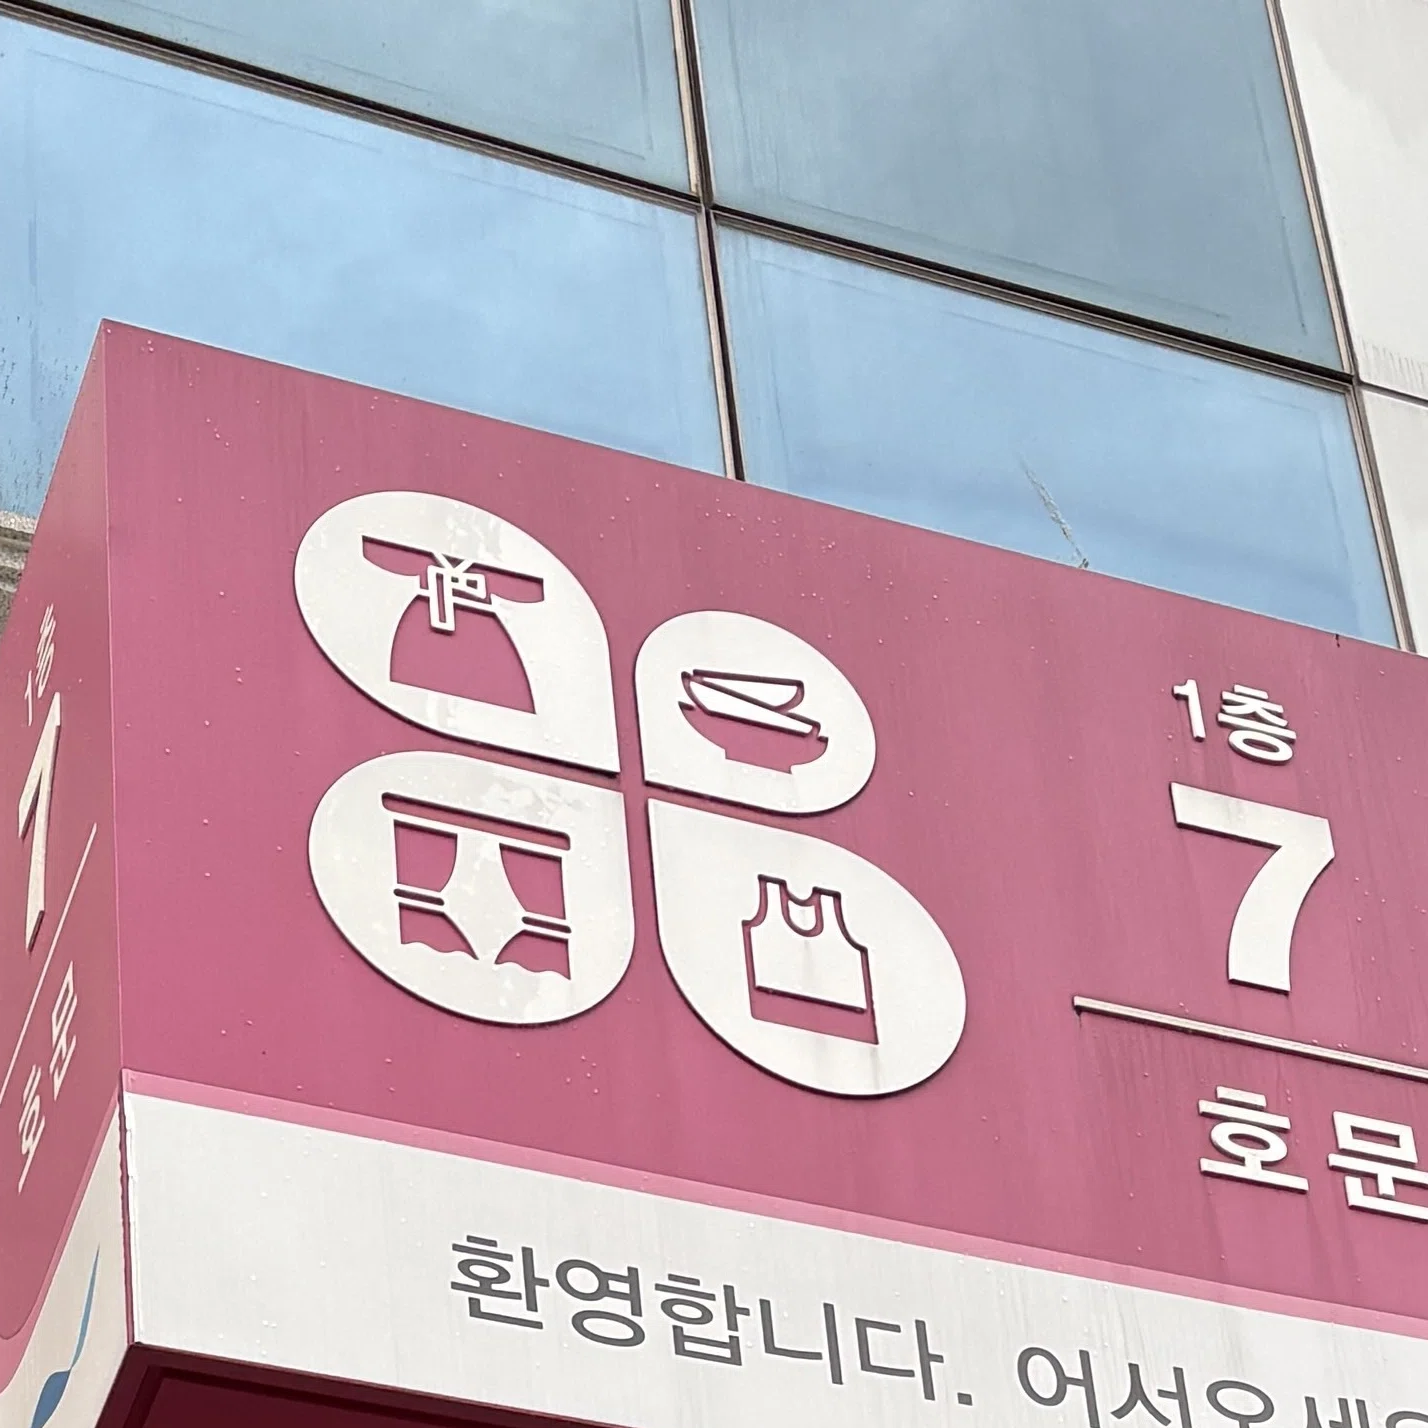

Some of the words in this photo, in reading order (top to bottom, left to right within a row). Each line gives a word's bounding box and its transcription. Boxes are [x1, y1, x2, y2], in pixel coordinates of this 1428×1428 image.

[24, 602, 56, 727] 1층
[1172, 678, 1297, 766] 1층
[18, 691, 61, 953] 7
[1170, 781, 1335, 996] 7
[450, 1234, 973, 1407] 환영합니다.
